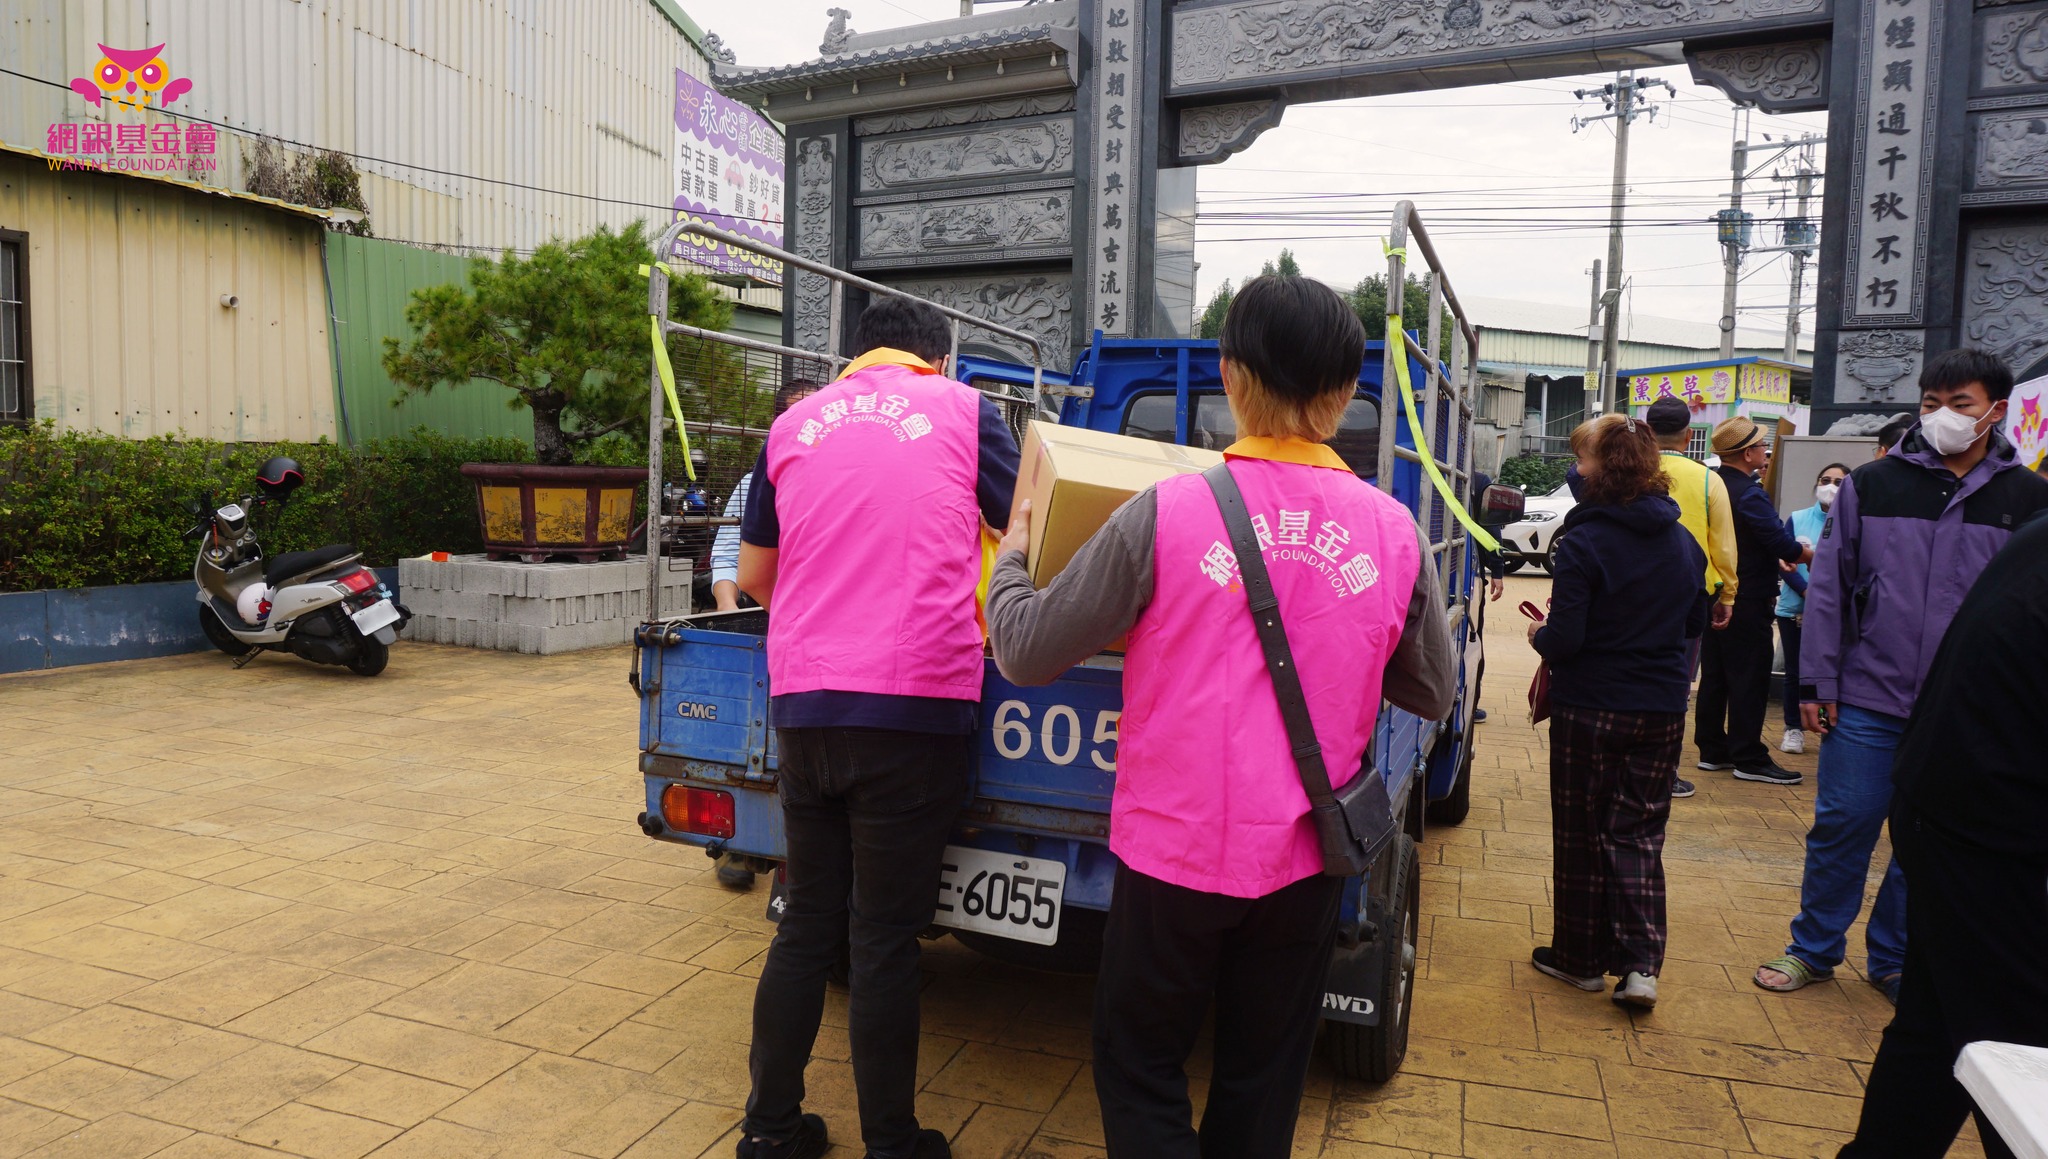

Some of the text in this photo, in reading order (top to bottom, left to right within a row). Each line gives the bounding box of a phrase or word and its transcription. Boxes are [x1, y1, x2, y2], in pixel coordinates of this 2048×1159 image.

[699, 90, 738, 142] 永心
[681, 142, 719, 178] 中古車
[1865, 0, 1917, 308] 經顯通千秋不朽
[797, 391, 933, 447] 網銀基金會
[845, 415, 908, 443] FOUNDATION
[1272, 549, 1348, 598] FOUNDATION
[677, 701, 718, 721] CMC
